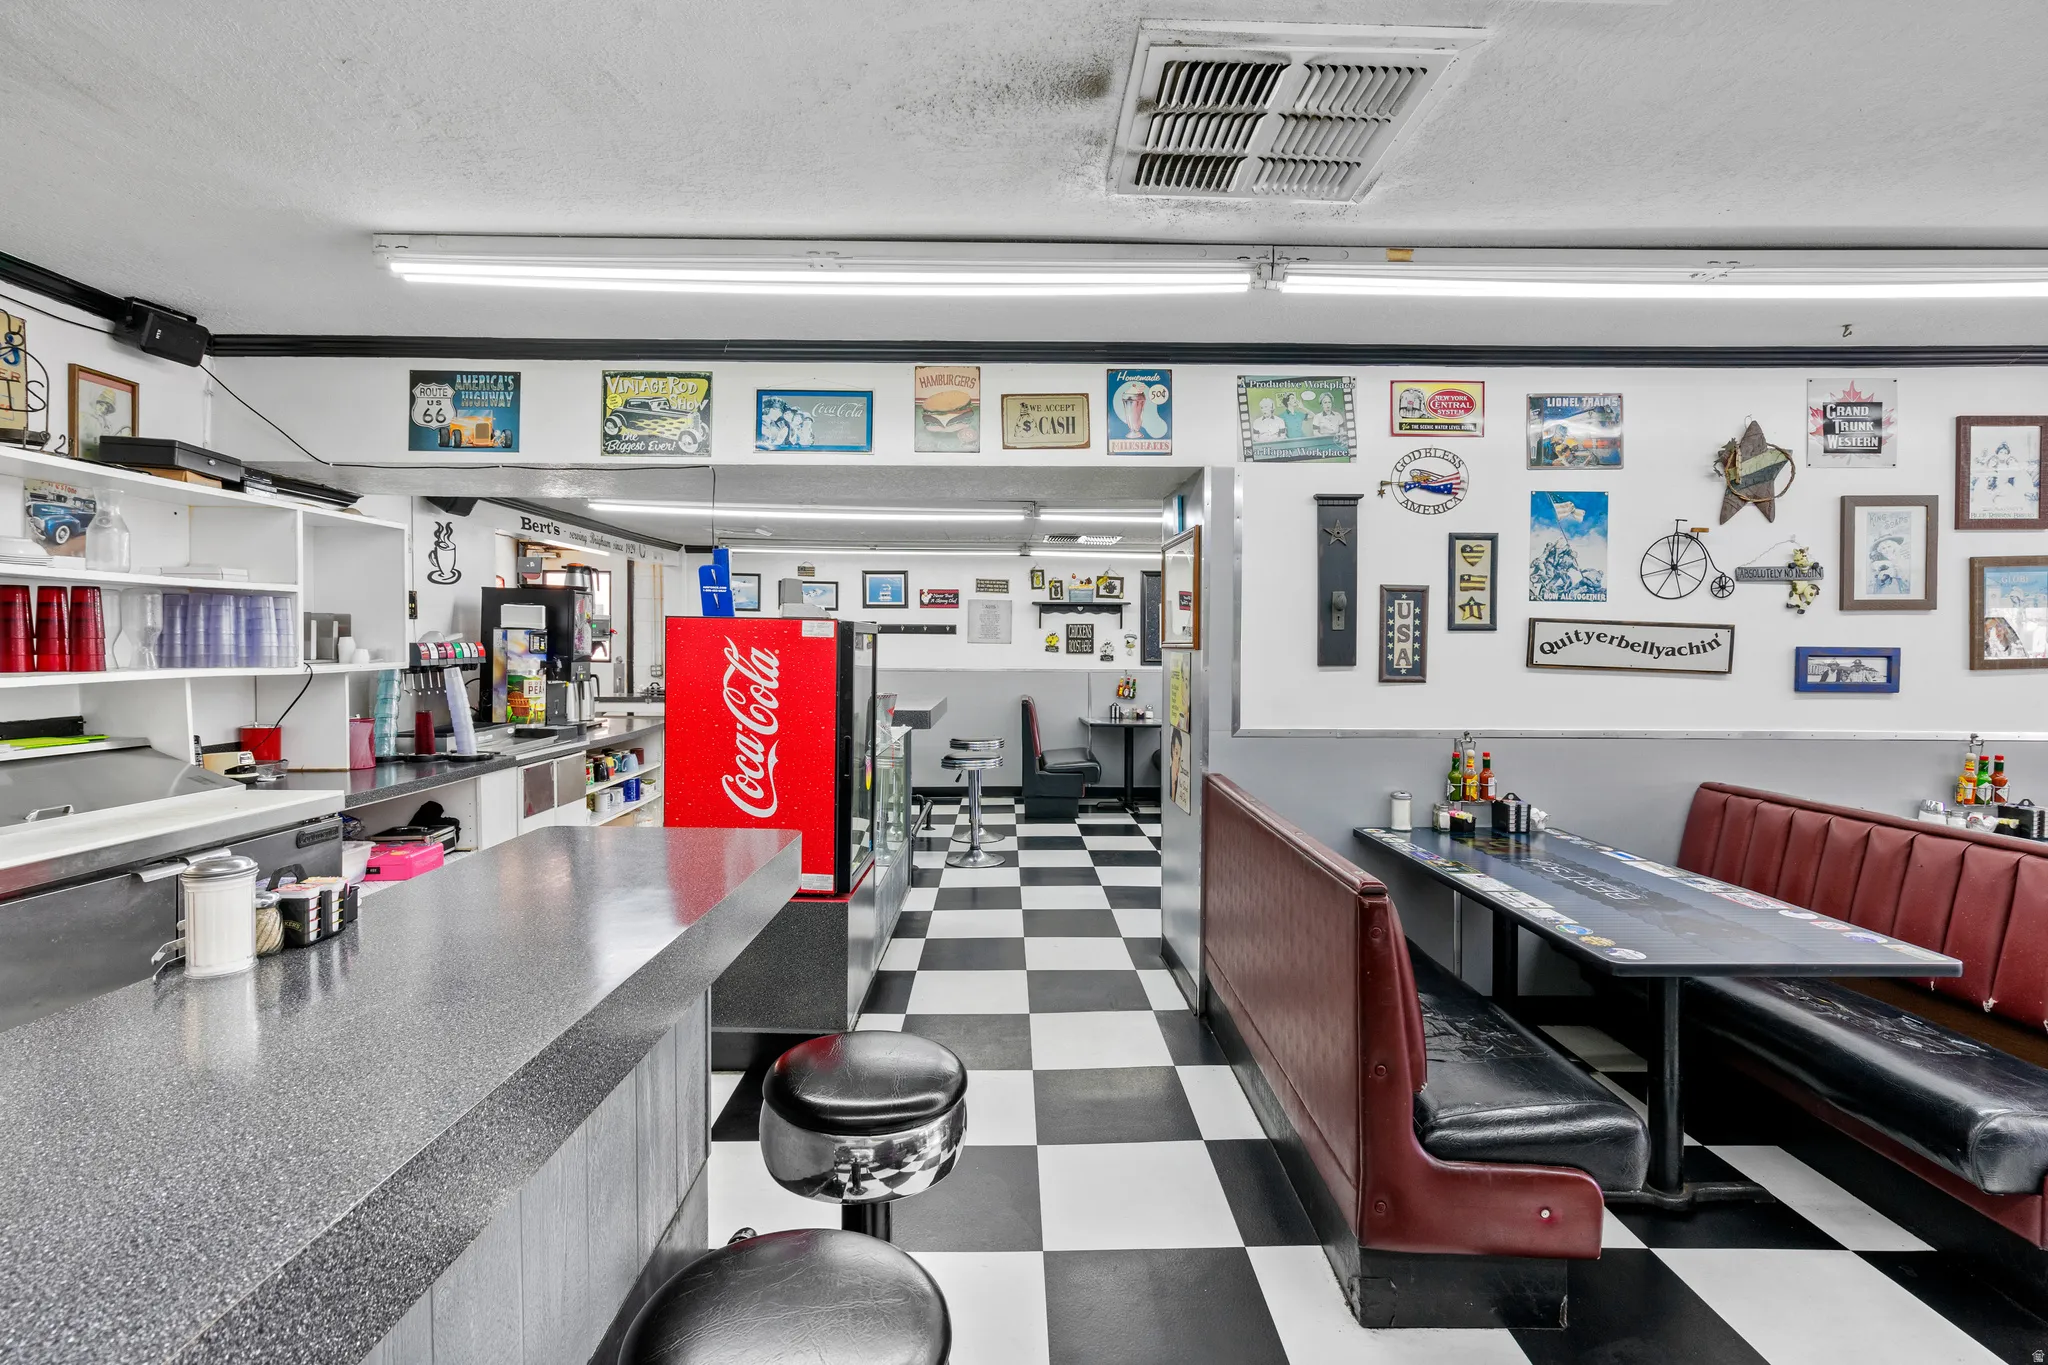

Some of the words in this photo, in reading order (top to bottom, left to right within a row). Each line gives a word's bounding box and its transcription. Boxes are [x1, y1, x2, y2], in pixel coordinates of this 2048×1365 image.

[455, 374, 515, 391] AMERICA'S
[919, 374, 976, 389] HAMBURGERS
[1117, 371, 1161, 382] Homemade
[419, 387, 448, 397] ROUTE
[605, 375, 668, 396] VINTAGE
[1250, 380, 1302, 389] Productive
[1304, 380, 1355, 390] Workplace
[461, 391, 514, 408] HIGHWAY
[1430, 400, 1473, 409] CENTRAL
[1546, 397, 1580, 407] LIONEL
[1582, 397, 1619, 407] TRAINS
[422, 407, 447, 424] 66
[1029, 404, 1042, 412] WE
[1044, 404, 1076, 412] ACCEPT
[1039, 416, 1076, 435] CASH
[605, 441, 646, 453] Biggest
[648, 440, 677, 451] Ever!
[1263, 448, 1294, 458] Happy
[1297, 447, 1349, 457] Workplace
[1395, 450, 1421, 473] GOD
[1424, 448, 1464, 469] BLESS
[1400, 496, 1463, 514] AMERICA
[520, 516, 561, 536] Bert's
[569, 531, 587, 546] serving
[1740, 568, 1782, 578] ABSOLUTELY
[1784, 569, 1794, 578] NO
[1068, 624, 1093, 638] CHICKENS
[1395, 602, 1412, 666] USA
[1539, 629, 1722, 659] Quityerbellyachin'
